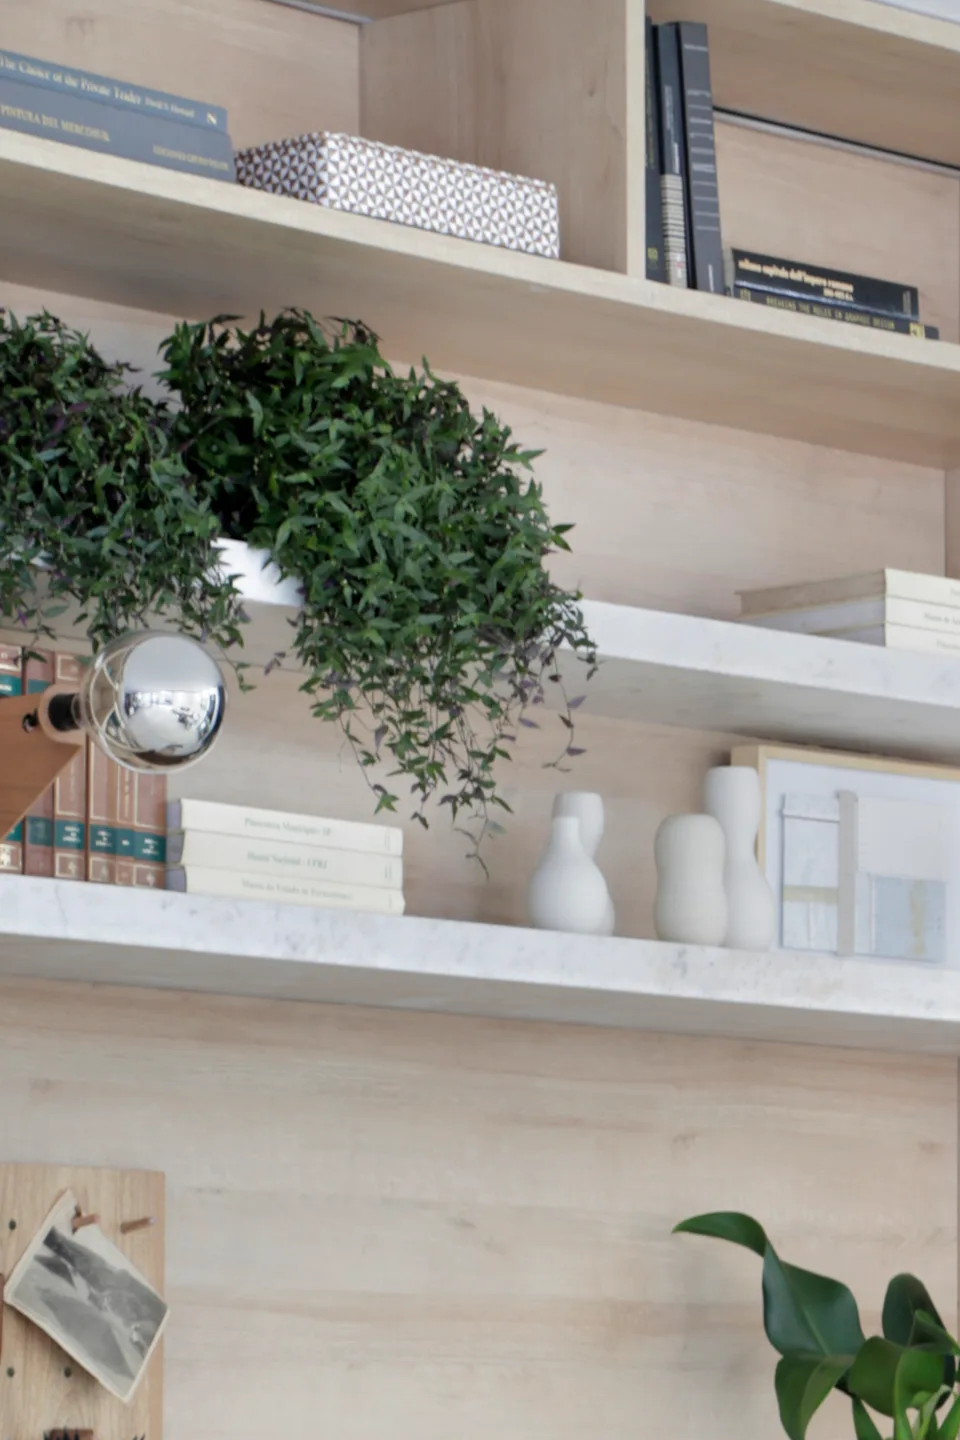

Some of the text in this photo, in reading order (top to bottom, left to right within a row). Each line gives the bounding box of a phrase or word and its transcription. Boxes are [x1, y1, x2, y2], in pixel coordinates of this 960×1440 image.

[18, 60, 50, 80] Choice
[53, 72, 62, 83] of
[65, 75, 79, 88] the
[80, 76, 111, 97] Private
